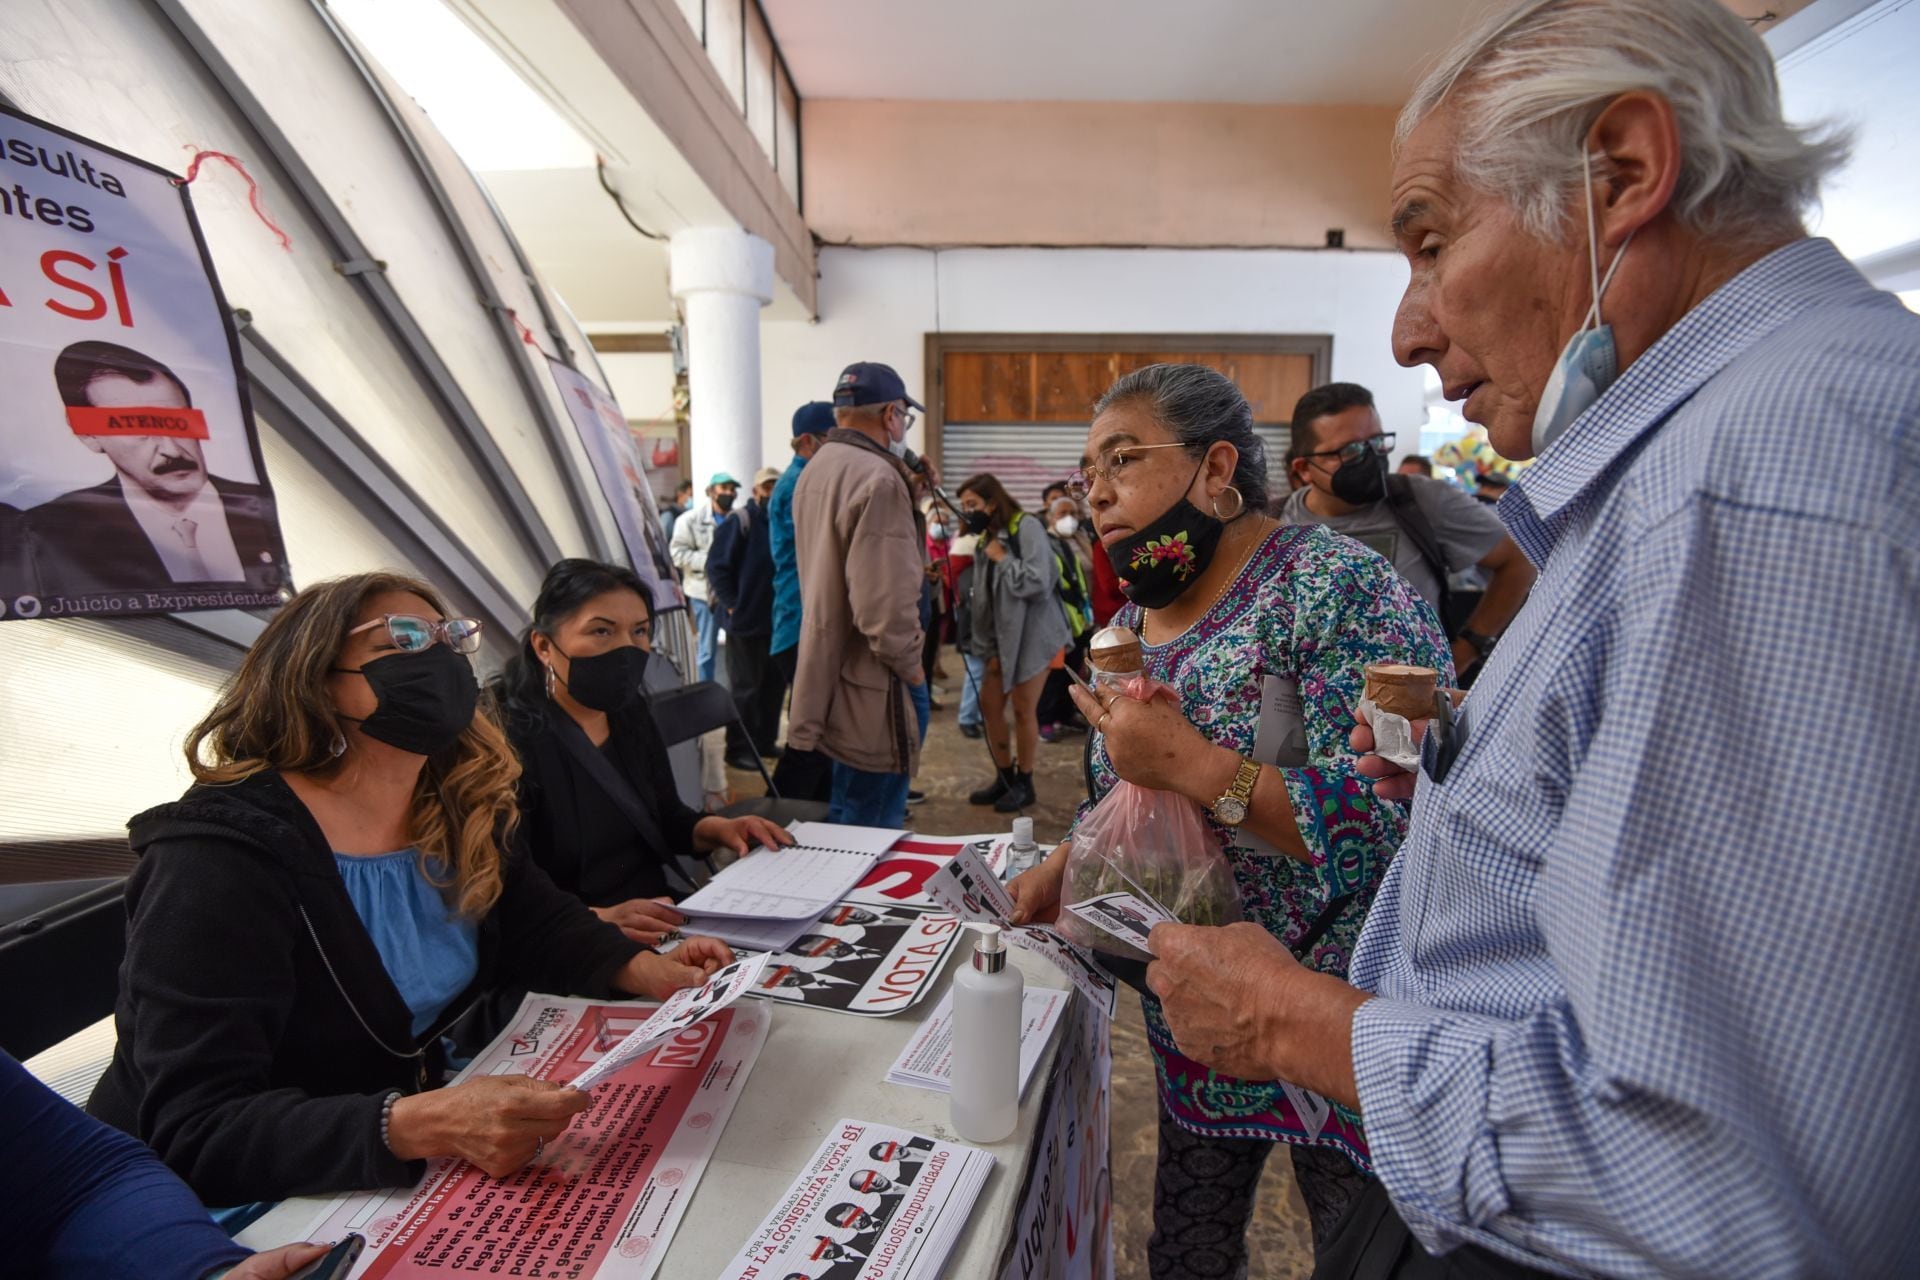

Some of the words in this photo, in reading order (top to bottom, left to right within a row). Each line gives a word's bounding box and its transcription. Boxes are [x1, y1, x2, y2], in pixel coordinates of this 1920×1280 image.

[40, 246, 134, 328] SÍ
[107, 414, 189, 432] ATENCO
[50, 597, 122, 614] Juicio
[128, 599, 143, 610] a
[147, 592, 281, 610] Expresidentes
[867, 939, 947, 1003] VOTA
[523, 1007, 553, 1040] CONSULTA
[531, 1007, 561, 1040] POPULAR
[658, 1022, 709, 1066] NO
[629, 1126, 647, 1141] los
[641, 1085, 672, 1125] derechos
[466, 1237, 502, 1271] legal,
[497, 1207, 523, 1233] para
[599, 1082, 612, 1094] de
[489, 1181, 559, 1274] esclarecimiento
[590, 1083, 626, 1128] decisiones
[508, 1222, 551, 1276] políticas
[544, 1173, 583, 1221] tomadas
[599, 1120, 618, 1145] años
[614, 1084, 642, 1119] pasados
[528, 1254, 548, 1278] por
[541, 1232, 563, 1251] los
[559, 1187, 592, 1230] actores
[618, 1084, 656, 1138] encaminado
[600, 1151, 632, 1188] justicia
[627, 1142, 640, 1150] y
[369, 1233, 388, 1249] Lea
[385, 1221, 399, 1232] la
[396, 1171, 443, 1221] descripción
[392, 1203, 435, 1246] Marque
[428, 1194, 444, 1204] la
[441, 1162, 471, 1193] respu
[413, 1227, 449, 1266] ¿Estás
[448, 1206, 466, 1221] de
[465, 1173, 491, 1200] acue
[427, 1229, 467, 1267] lleven
[462, 1220, 474, 1228] a
[470, 1192, 496, 1218] cabo
[451, 1246, 474, 1269] con
[472, 1205, 505, 1241] apego
[503, 1190, 516, 1200] al
[591, 1190, 608, 1201] la
[745, 1240, 764, 1259] POR
[762, 1227, 774, 1241] LA
[769, 1195, 799, 1228] VERDAD
[795, 1186, 805, 1196] Y
[801, 1174, 814, 1187] LA
[812, 1141, 839, 1175] JUSTICIA
[754, 1244, 778, 1265] LA
[772, 1175, 829, 1242] CONSULTA
[821, 1143, 852, 1175] VOTA
[841, 1124, 865, 1142] SÍ
[778, 1235, 797, 1255] ESTE
[801, 1212, 813, 1223] DE
[810, 1183, 834, 1212] AGOSTO
[830, 1172, 841, 1183] DE
[840, 1155, 852, 1172] 2021
[555, 1203, 600, 1267] garantizar
[565, 1263, 584, 1280] de
[575, 1243, 596, 1261] las
[590, 1191, 625, 1241] posibles
[548, 1271, 560, 1279] a
